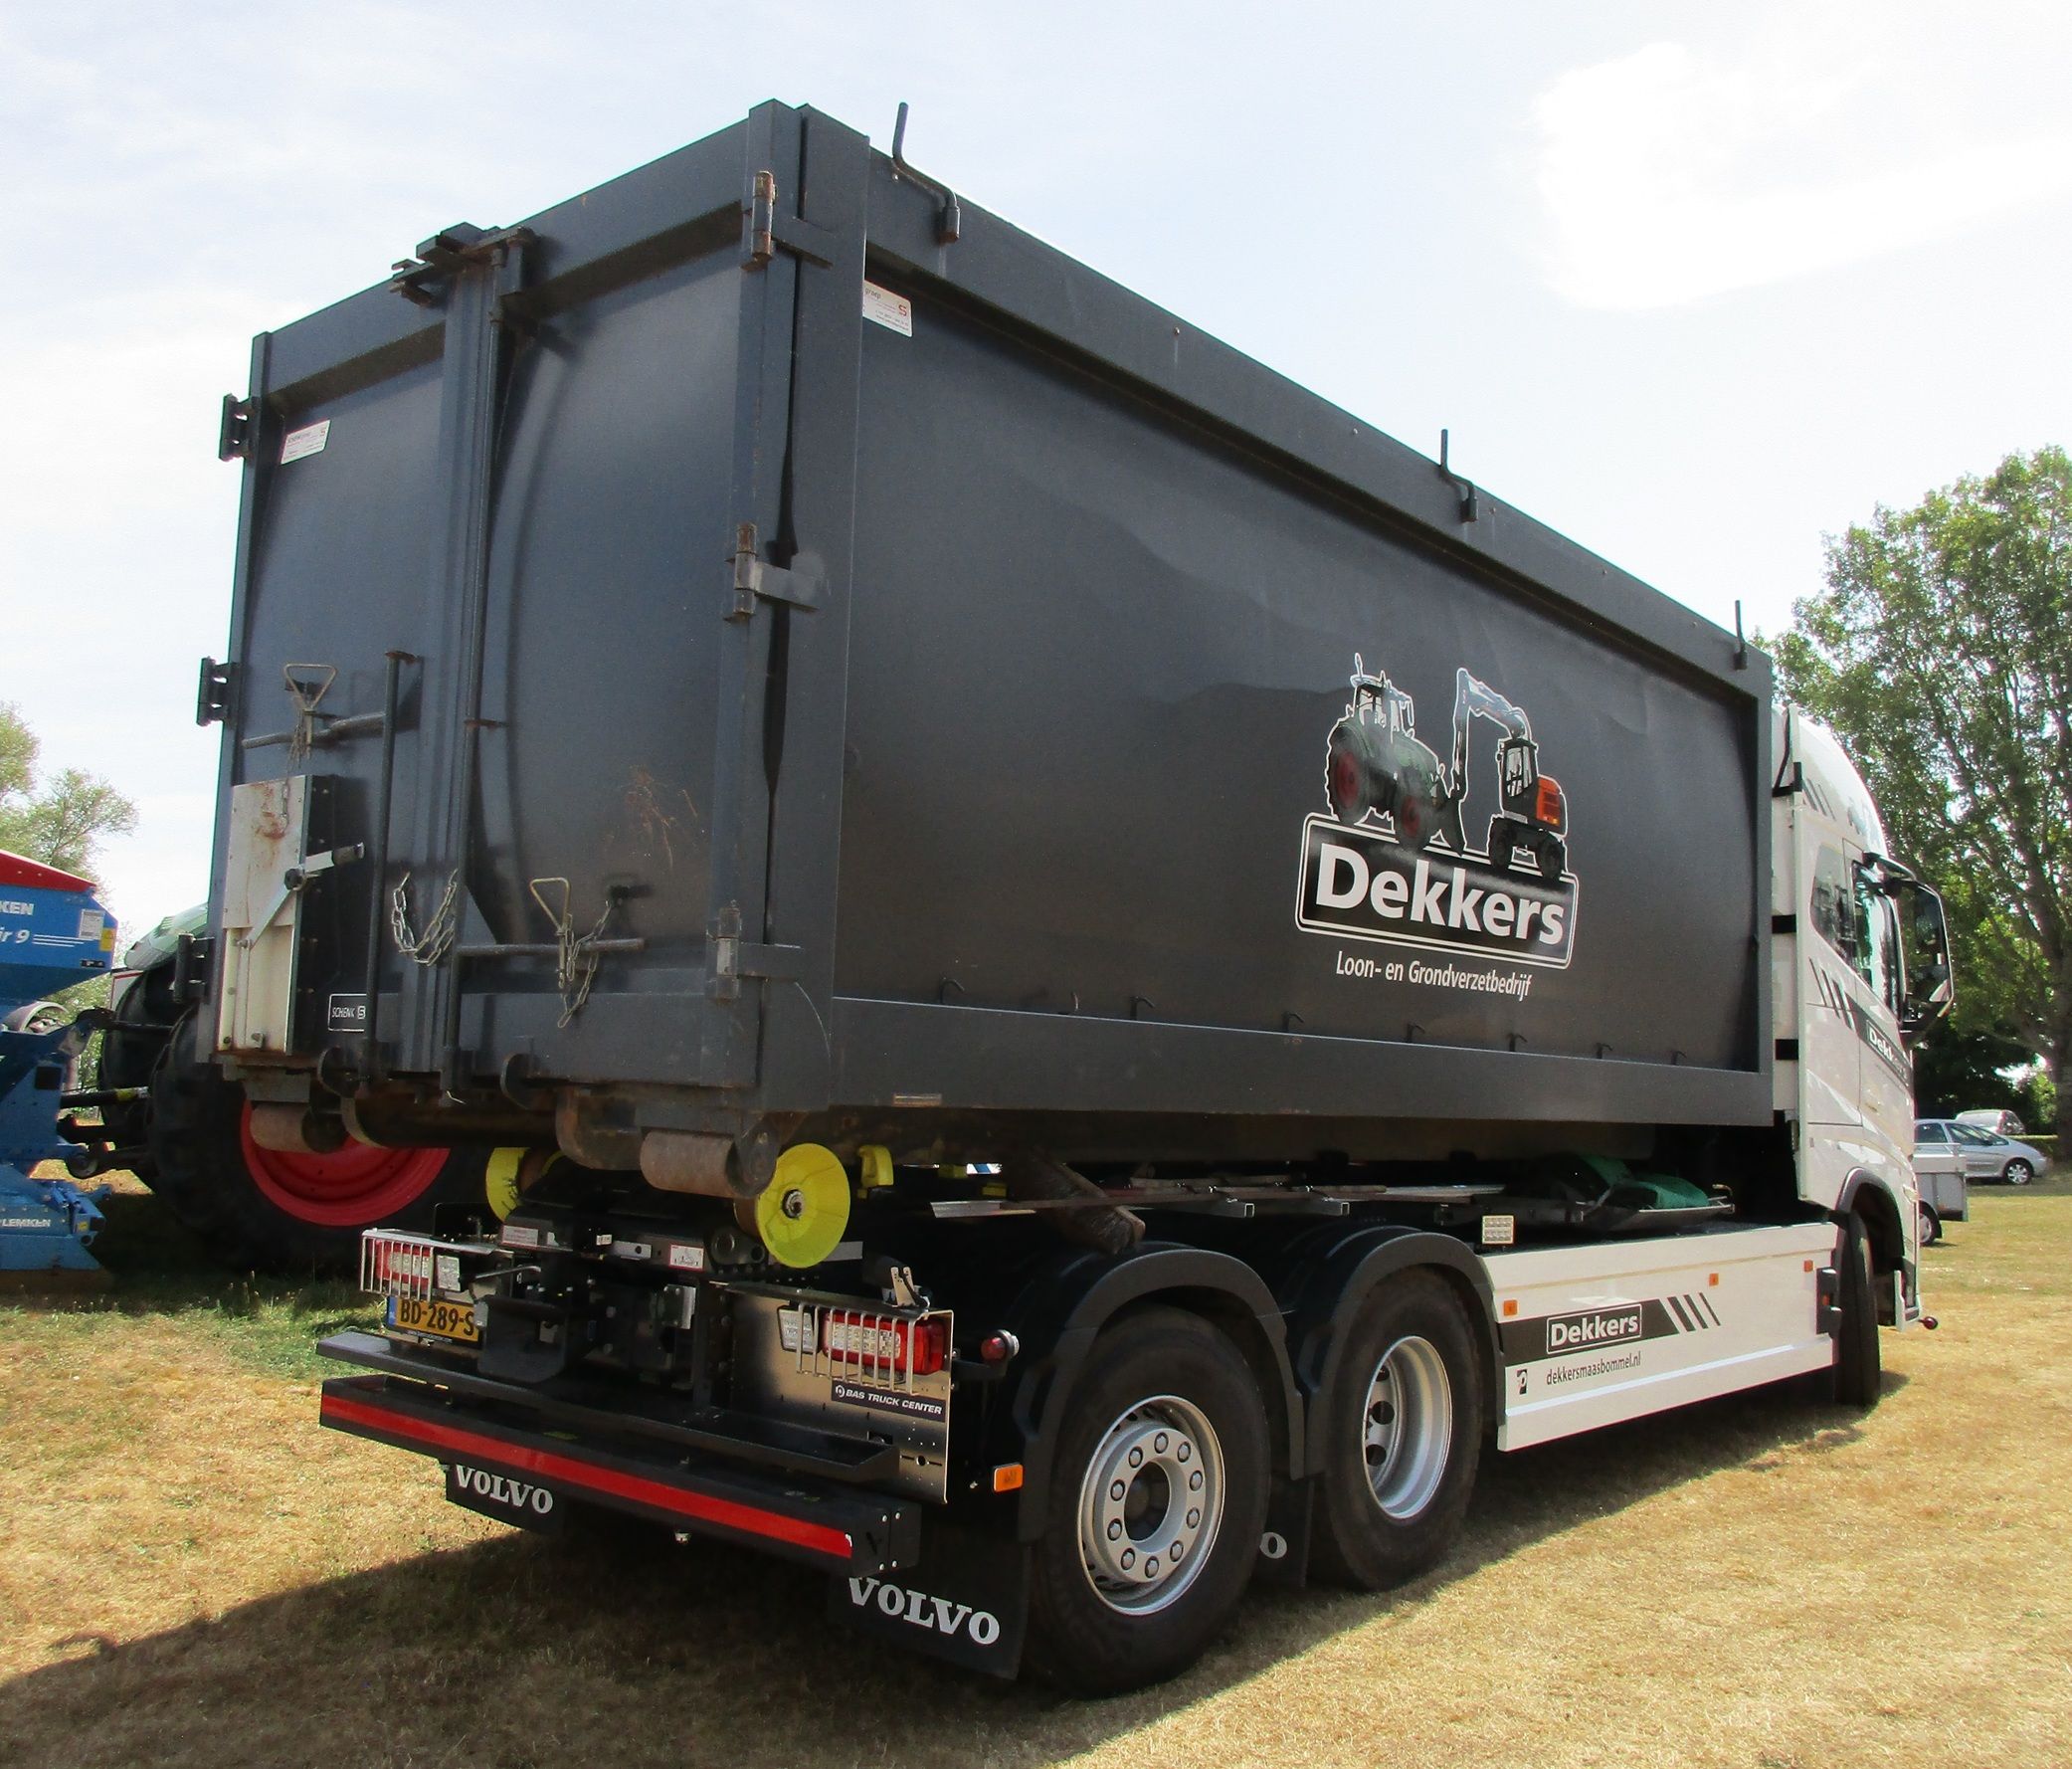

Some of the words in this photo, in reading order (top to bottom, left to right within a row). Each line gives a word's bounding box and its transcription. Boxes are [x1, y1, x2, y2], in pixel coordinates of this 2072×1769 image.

[1315, 843, 1565, 946] Dekkers
[15, 929, 31, 944] 9
[1336, 950, 1382, 978] Loon-
[1386, 961, 1404, 982] en
[1409, 960, 1533, 1002] Grondverzetbedrijf
[2, 1218, 52, 1228] LEMKEN
[400, 1298, 474, 1336] BD-289-S
[1551, 1315, 1638, 1347] Dekkers
[1546, 1351, 1641, 1385] dekkersmaasbommel.nl
[846, 1389, 864, 1400] BAS
[867, 1393, 899, 1407] TRUCK
[902, 1400, 943, 1415] CENTER
[456, 1464, 554, 1514] VOLVO
[848, 1576, 1001, 1645] VOLVO
